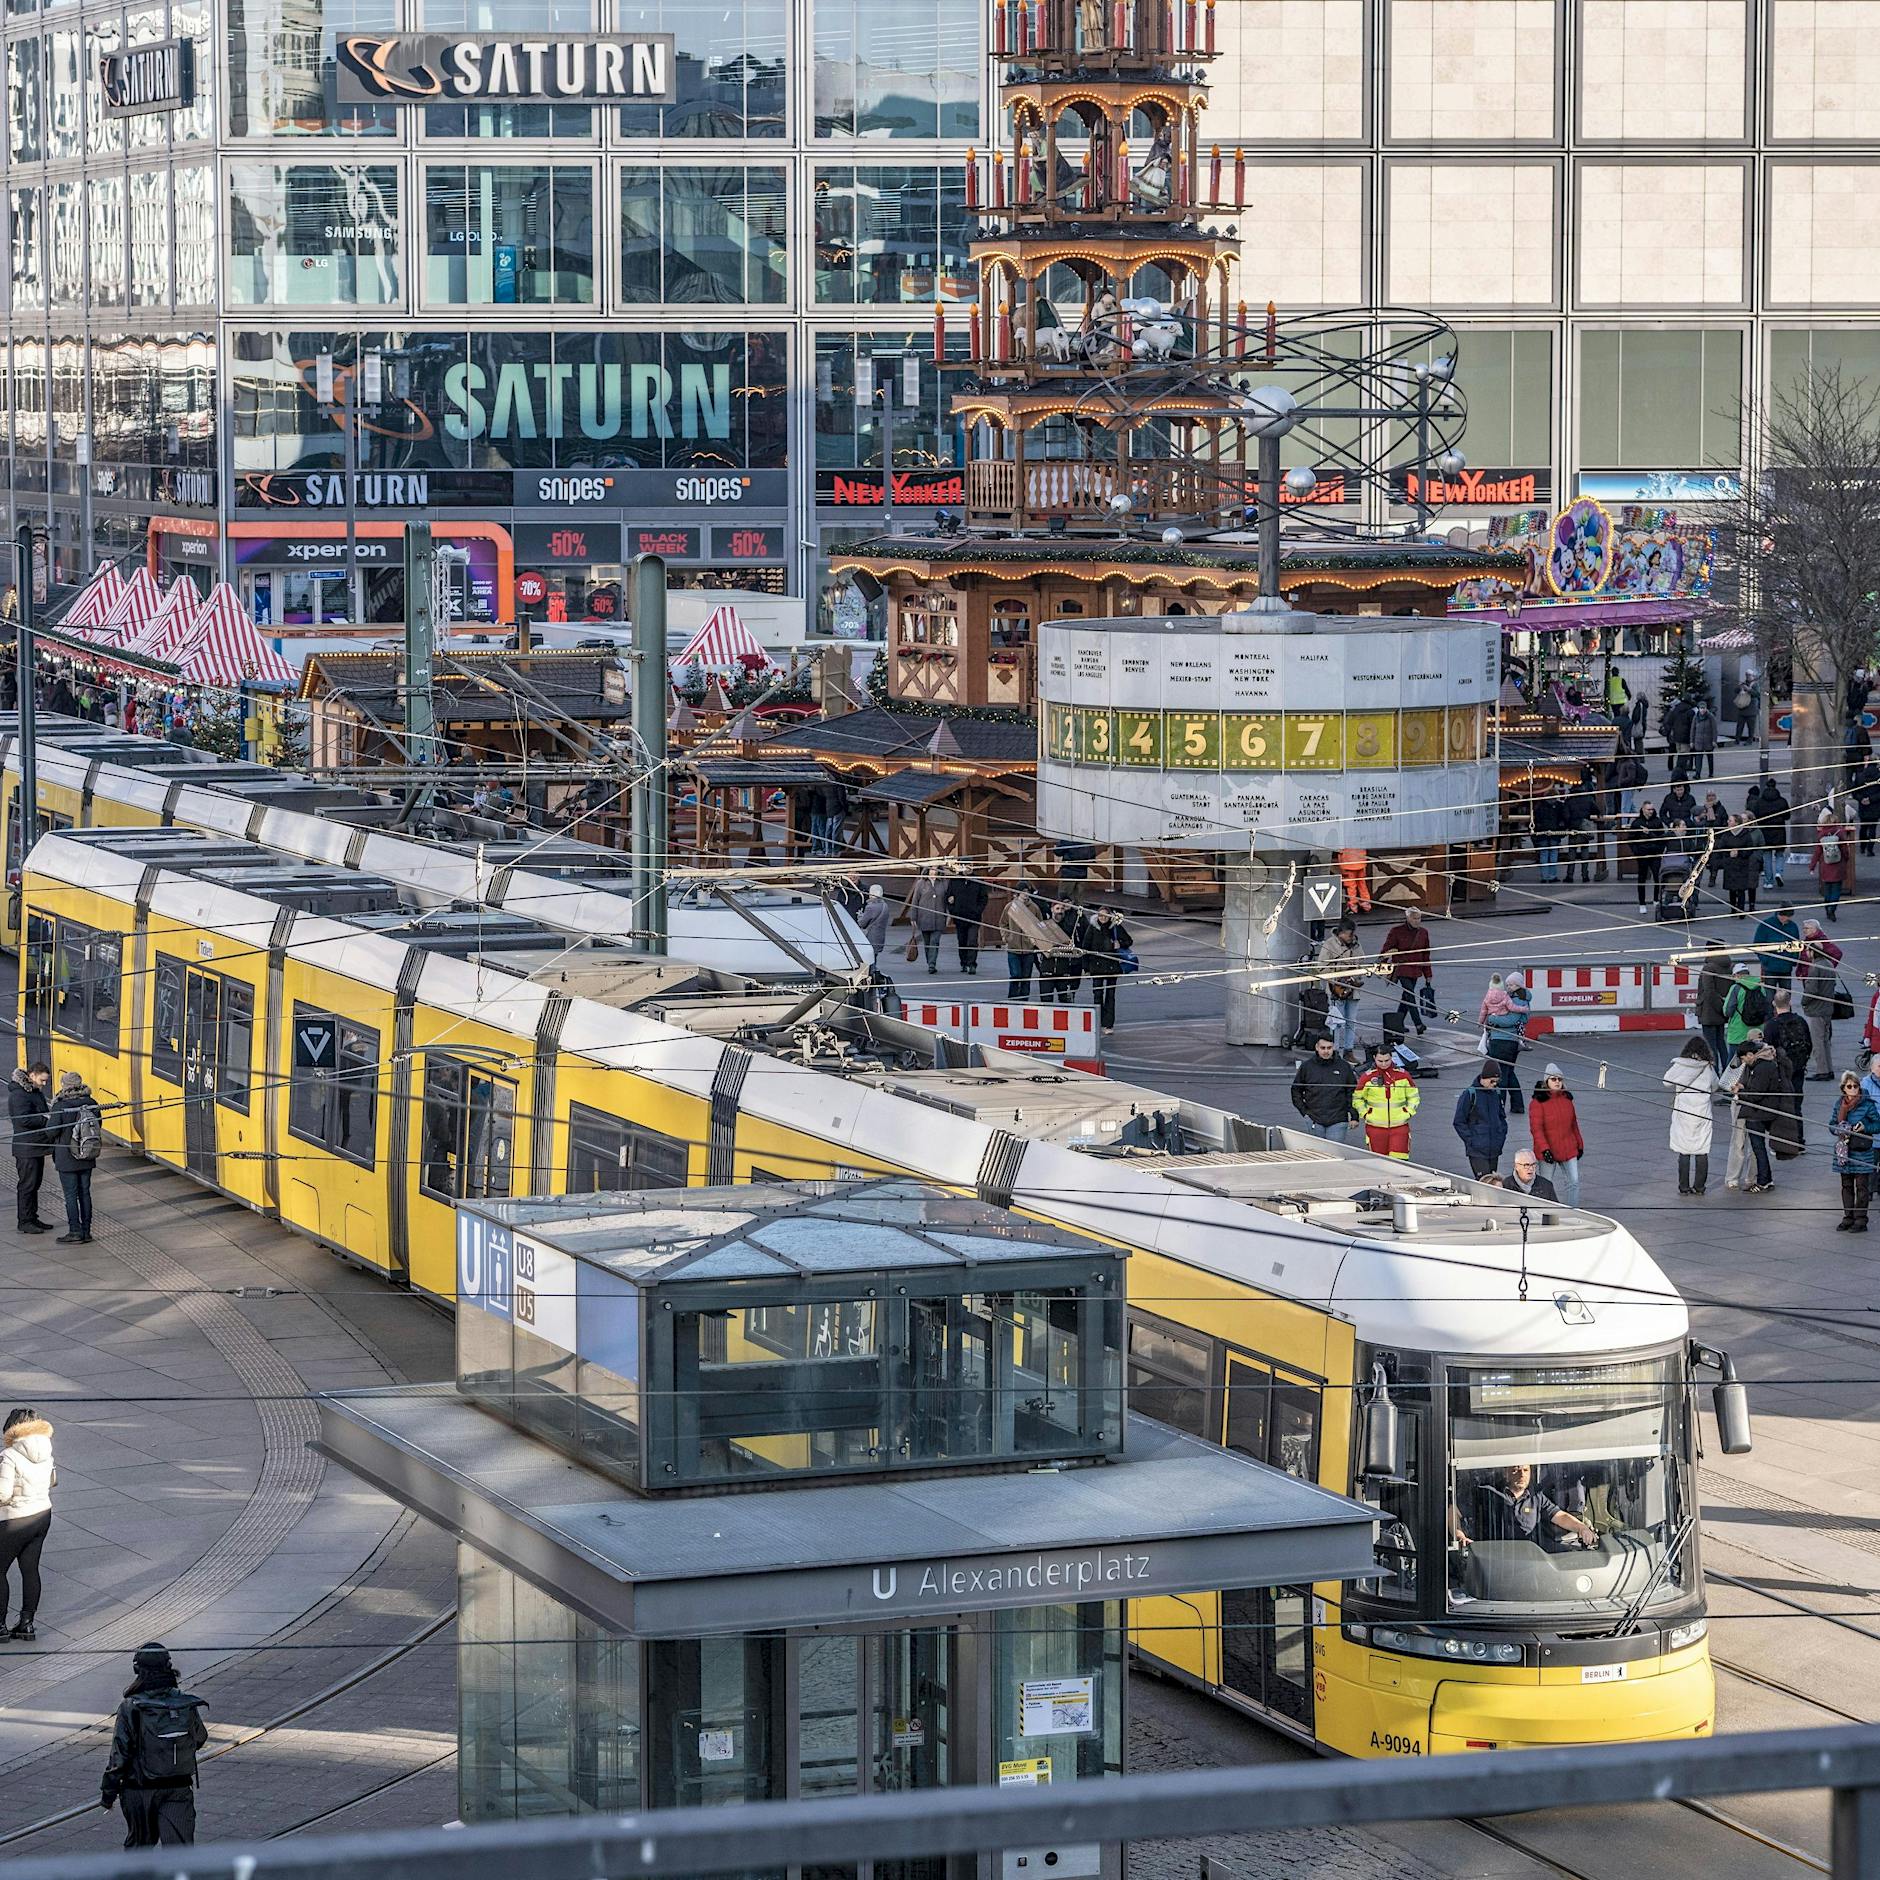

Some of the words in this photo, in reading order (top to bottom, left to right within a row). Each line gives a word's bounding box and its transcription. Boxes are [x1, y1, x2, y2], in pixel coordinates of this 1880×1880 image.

[122, 48, 174, 106] SATURN
[452, 41, 667, 95] SATURN
[325, 226, 392, 239] SAMSUNG
[450, 232, 464, 241] LG
[315, 259, 328, 267] LG
[444, 362, 730, 440] SATURN
[176, 472, 208, 503] SATURN
[305, 474, 428, 505] SATURN
[538, 477, 606, 505] snipes
[675, 477, 742, 505] snipes
[181, 539, 208, 556] xperion
[547, 532, 587, 557] -50%
[639, 533, 689, 543] BLACK
[639, 543, 688, 553] WEEK
[728, 532, 768, 557] -50%
[287, 543, 387, 561] xperon
[519, 580, 542, 596] -70%
[591, 598, 614, 614] -50%
[1064, 715, 1076, 748] 2
[1092, 718, 1109, 752] 3
[1129, 721, 1153, 754] 4
[1184, 722, 1207, 756] 5
[1240, 723, 1267, 757] 6
[1297, 722, 1325, 756] 7
[1356, 722, 1380, 757] 8
[1406, 719, 1427, 754] 9
[1005, 1039, 1042, 1048] ZEPPELIN
[461, 1216, 481, 1299] U
[518, 1246, 533, 1277] U8
[518, 1288, 533, 1320] U5
[872, 1567, 897, 1599] U
[918, 1550, 1150, 1597] Alexanderplatz
[1584, 1670, 1610, 1679] BERLIN
[1370, 1731, 1421, 1756] A-9094
